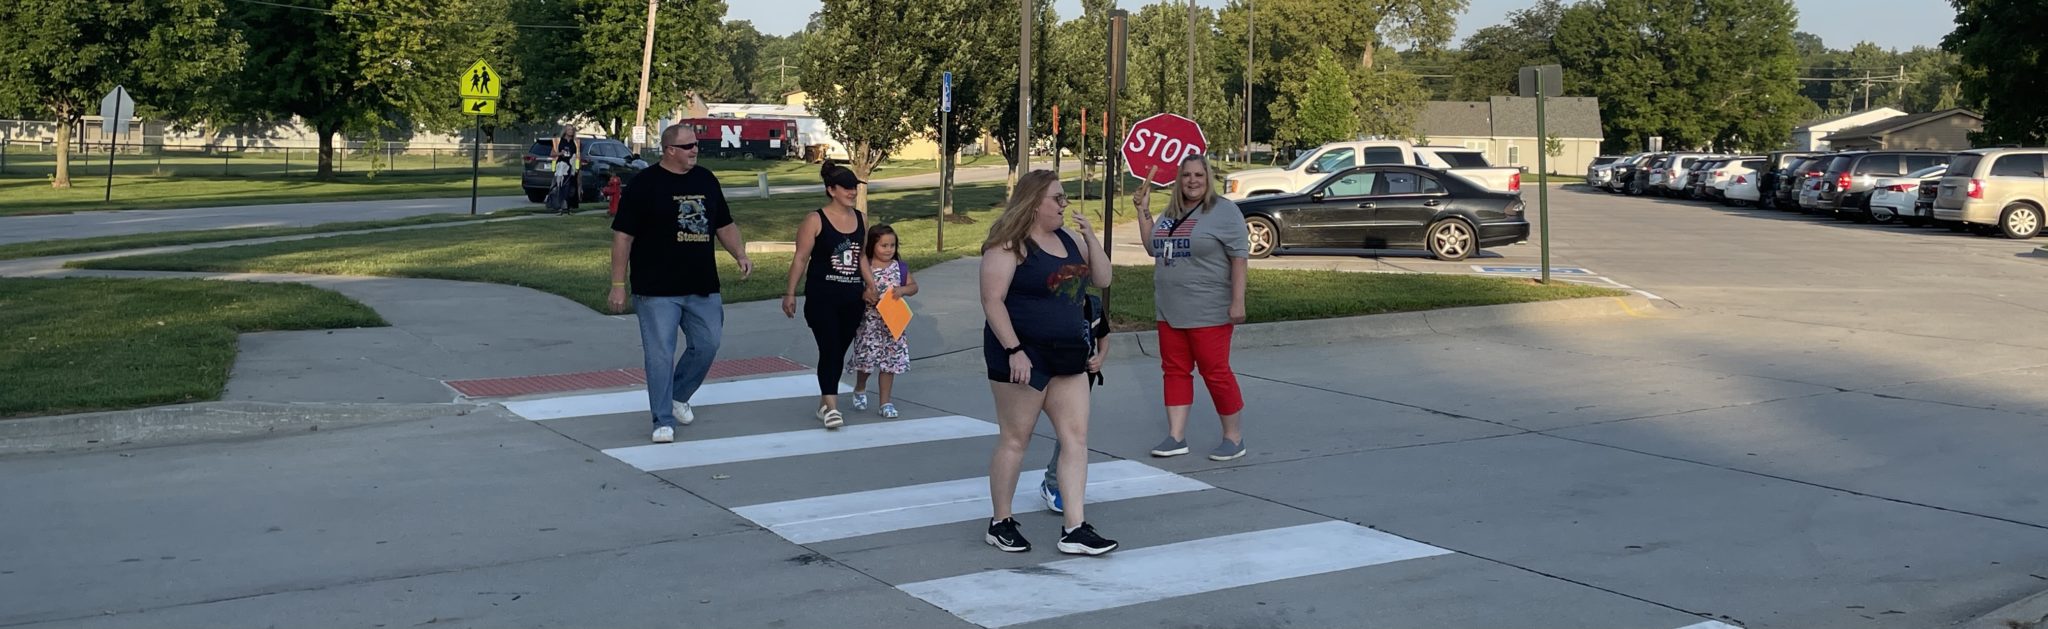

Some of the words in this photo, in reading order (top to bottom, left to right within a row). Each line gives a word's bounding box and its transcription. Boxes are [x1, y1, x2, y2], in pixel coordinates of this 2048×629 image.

[720, 125, 742, 148] N
[1129, 128, 1201, 166] STOP
[1153, 238, 1190, 249] UNTED
